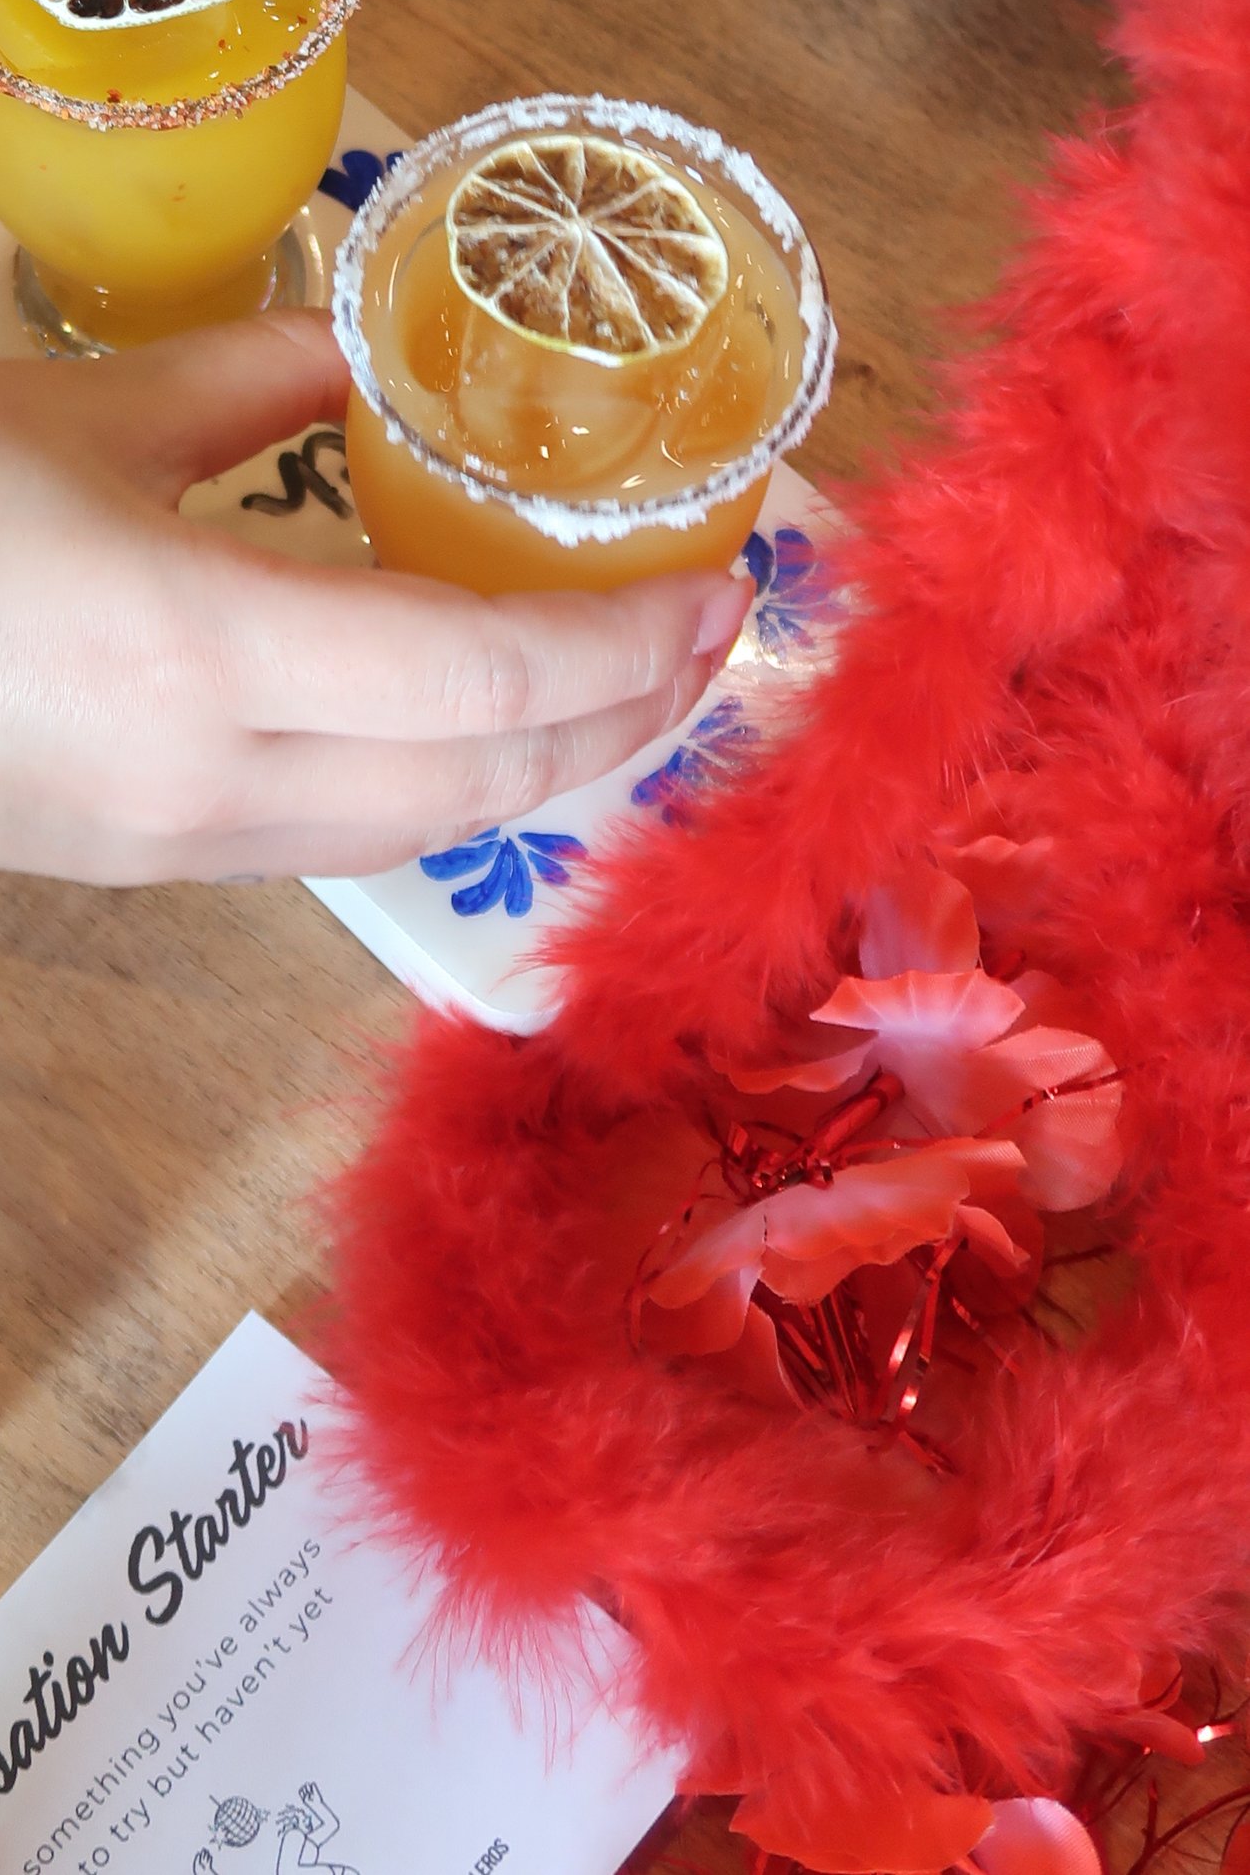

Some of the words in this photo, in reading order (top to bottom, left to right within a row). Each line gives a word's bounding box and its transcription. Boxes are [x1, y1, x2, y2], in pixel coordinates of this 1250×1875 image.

[127, 1418, 310, 1627] Starter
[23, 1725, 162, 1875] something
[157, 1636, 239, 1733] you've
[240, 1538, 321, 1634] always
[78, 1846, 111, 1875] to
[109, 1798, 152, 1844] try
[147, 1743, 201, 1798] but
[195, 1635, 292, 1744] haven't
[288, 1586, 334, 1642] yet
